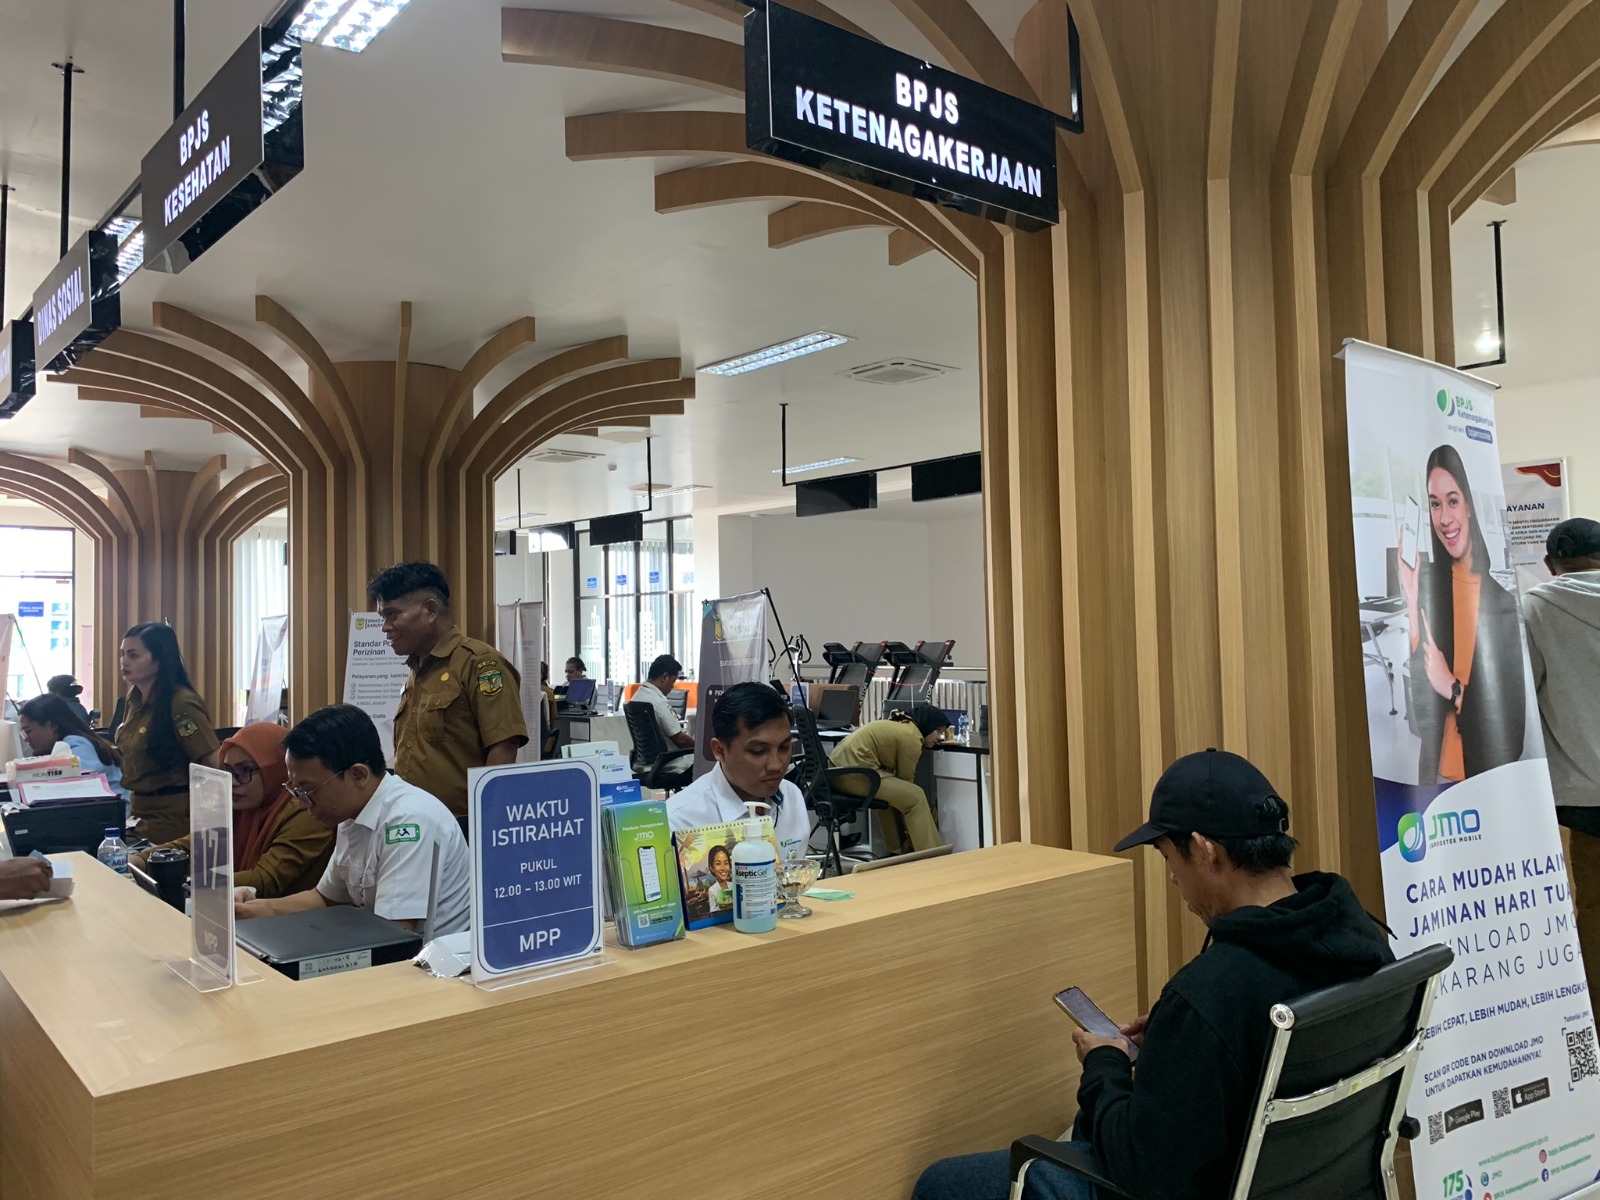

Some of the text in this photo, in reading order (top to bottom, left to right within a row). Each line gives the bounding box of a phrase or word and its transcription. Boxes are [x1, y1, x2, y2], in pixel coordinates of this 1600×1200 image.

[895, 72, 960, 125] BPJS
[179, 109, 209, 166] BPJS
[795, 85, 1043, 198] KETENAGAKERJAAN
[164, 135, 231, 227] KESEHATAN
[37, 266, 84, 345] DINAS SOSIAL
[1455, 395, 1473, 411] BPJS
[352, 648, 386, 656] Perizinan
[353, 640, 381, 648] Standar
[505, 798, 570, 822] WAKTU
[1428, 808, 1480, 841] JMO
[492, 817, 585, 847] ISTIRAHAT
[1459, 834, 1482, 843] MOBILE
[201, 827, 219, 890] 17
[520, 857, 558, 874] PUKUL
[736, 868, 757, 879] Aseptic
[757, 867, 768, 876] Gel
[494, 884, 522, 899] 12.00
[534, 877, 561, 892] 13.00
[562, 873, 582, 888] WIT
[1406, 875, 1447, 904] CARA
[1452, 862, 1516, 892] MUDAH
[1409, 900, 1487, 938] JAMINAN
[1494, 889, 1536, 916] HARI
[519, 927, 561, 953] MPP
[1442, 1012, 1468, 1032] CEPAT,
[1469, 1005, 1496, 1023] LEBIH
[1497, 997, 1530, 1016] MUDAH,
[1530, 990, 1554, 1006] LEBIH
[1424, 1066, 1442, 1083] SCAN
[1450, 1058, 1470, 1073] CODE
[1470, 1052, 1487, 1065] DAN
[1488, 1040, 1529, 1060] DOWNLOAD
[1529, 1035, 1544, 1048] JMO
[1425, 1049, 1543, 1098] UNTUK DAPATKAN KEMUDAHANNYA!
[1524, 1092, 1535, 1103] App
[1534, 1087, 1547, 1098] Store
[1454, 1111, 1471, 1124] Google
[1442, 1169, 1464, 1198] 175
